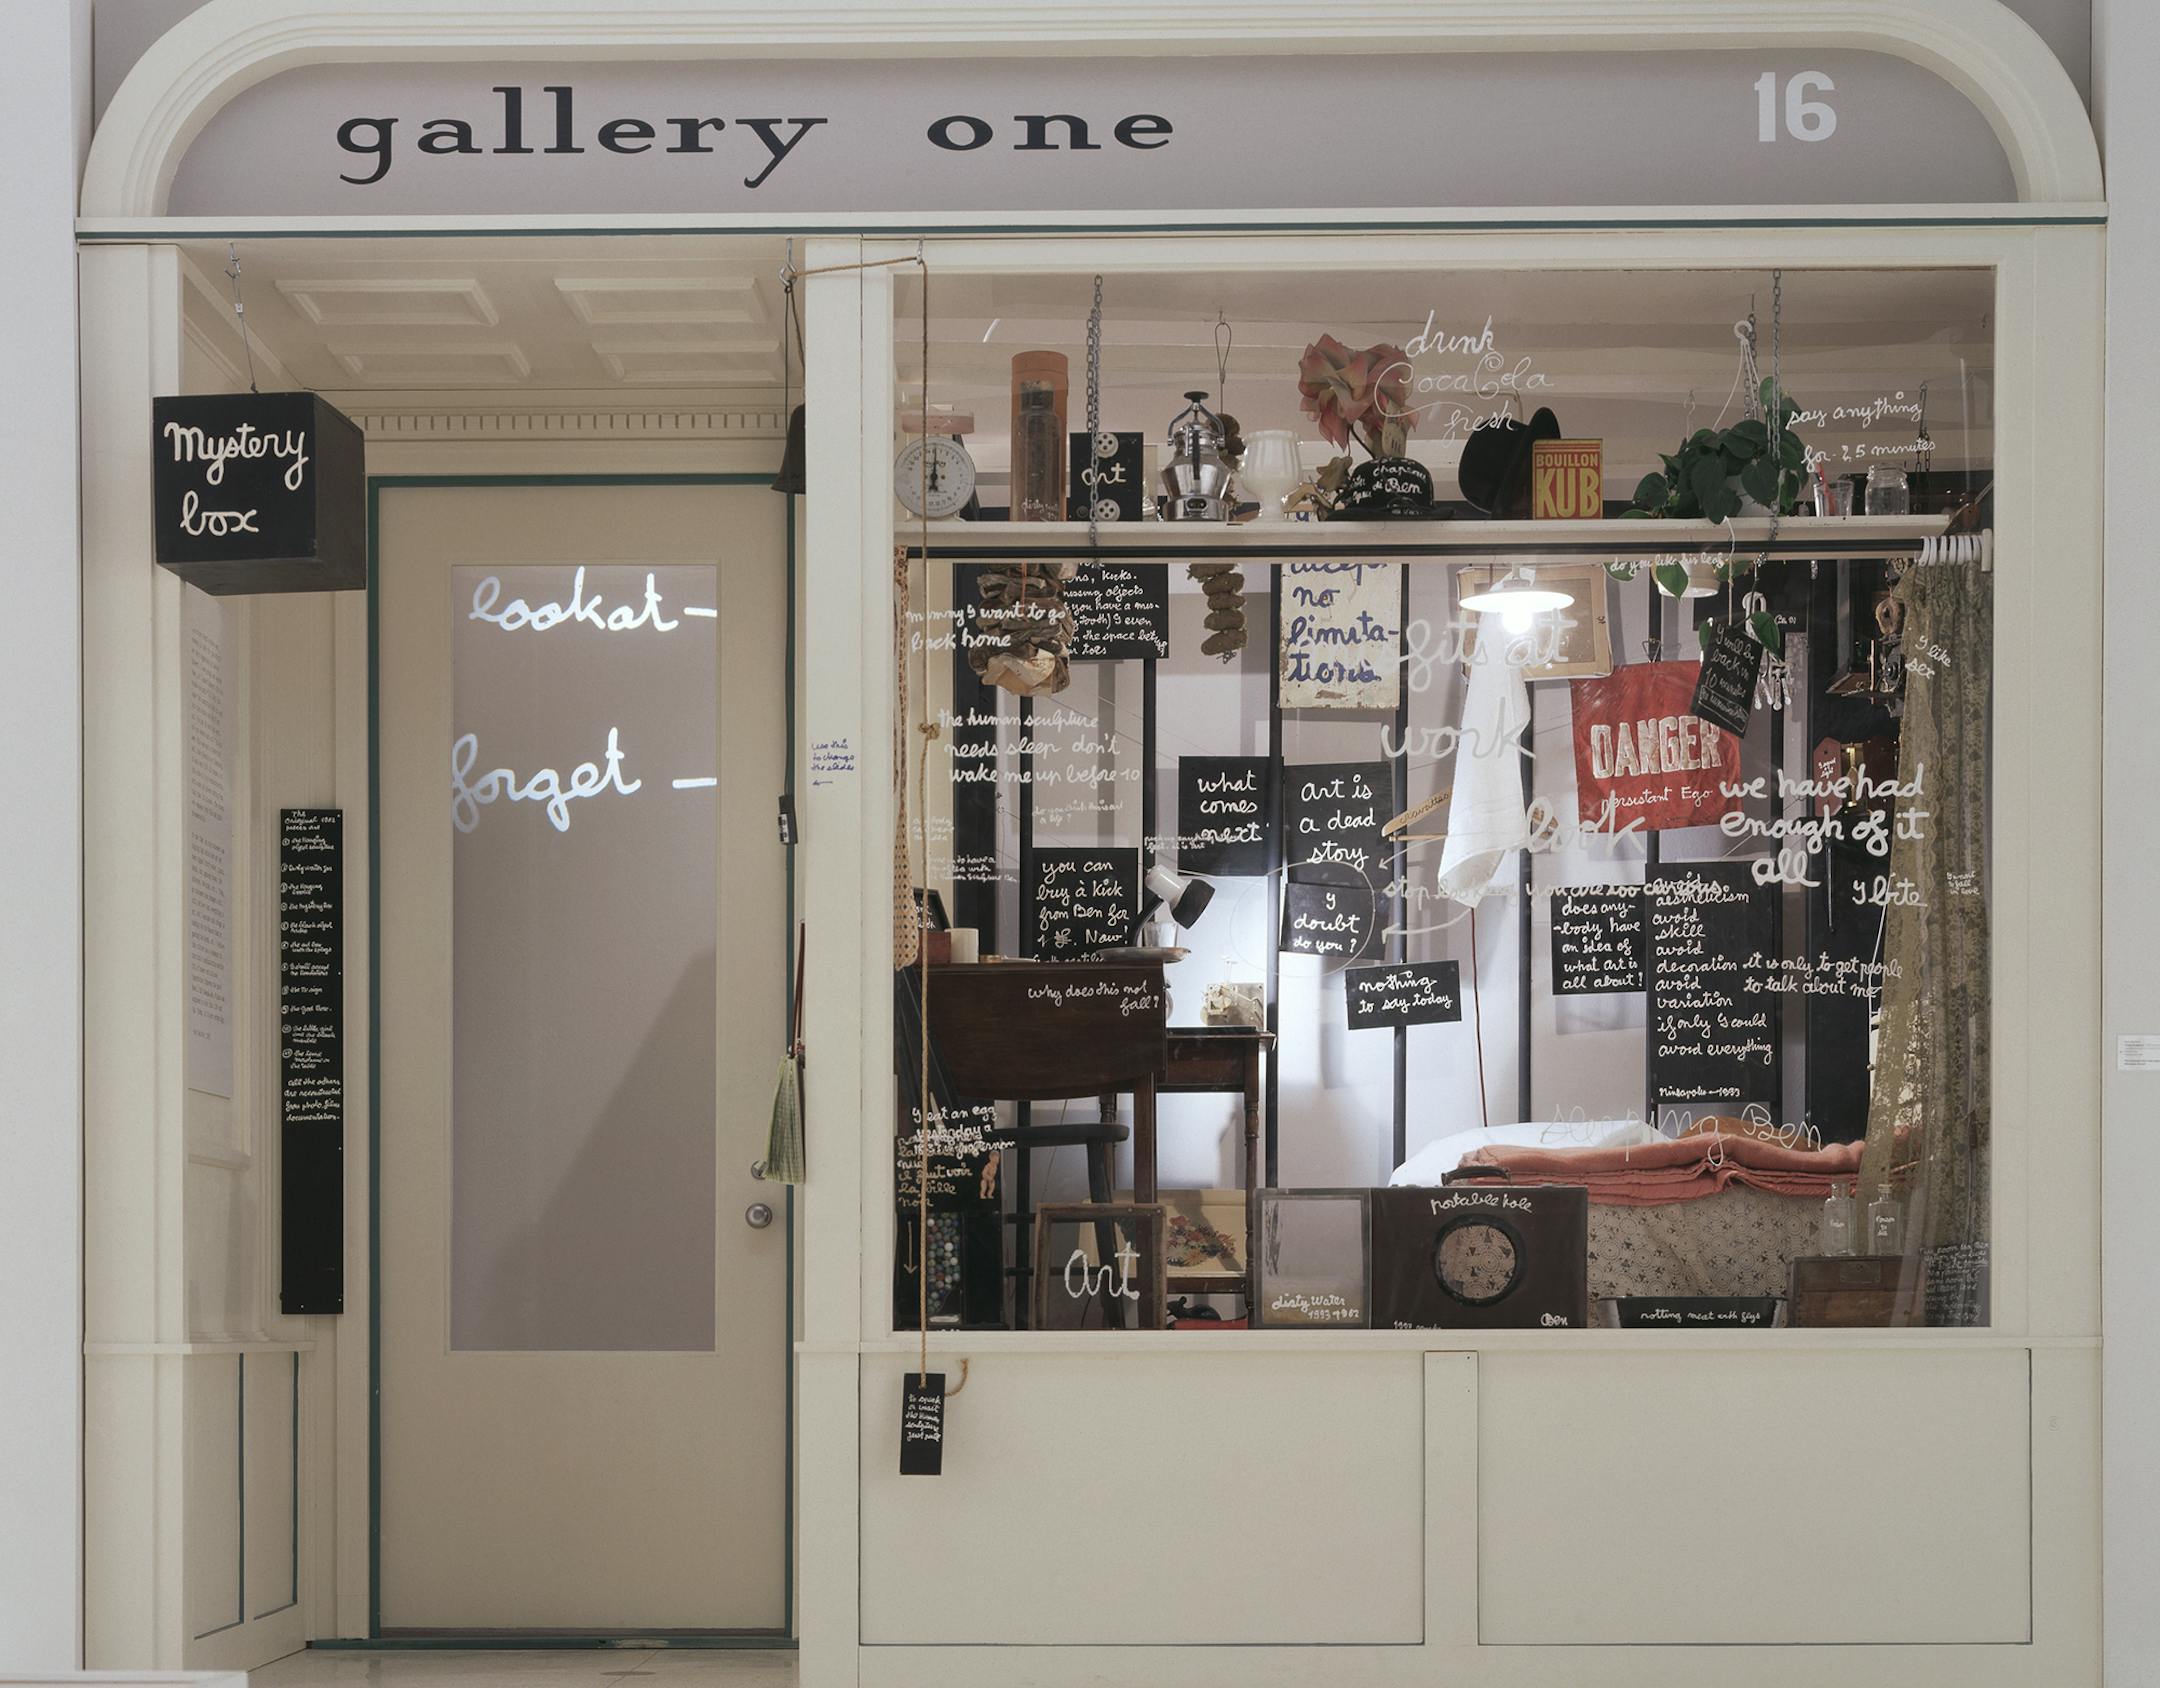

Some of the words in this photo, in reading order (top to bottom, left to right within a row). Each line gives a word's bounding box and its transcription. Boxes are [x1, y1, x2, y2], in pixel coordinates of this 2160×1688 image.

[1754, 71, 1837, 142] 16
[337, 87, 827, 188] gallery
[928, 115, 1173, 150] one
[1405, 309, 1495, 357] drink
[1785, 407, 1828, 429] say
[1832, 391, 1922, 429] anything
[1441, 400, 1515, 448] fresh
[164, 422, 309, 491] Mystery
[1870, 437, 1936, 457] minutes
[1535, 453, 1600, 468] BOUILLON
[1535, 467, 1601, 519] KUB
[180, 491, 260, 537] box
[1123, 602, 1132, 611] a
[1292, 586, 1340, 608] no
[980, 601, 1025, 620] want
[1027, 602, 1047, 620] to
[1047, 608, 1066, 625] go
[961, 627, 1013, 648] home
[1101, 632, 1136, 643] space
[1927, 644, 1952, 668] like
[1904, 657, 1936, 680] sex
[938, 708, 963, 728] the
[967, 707, 1021, 728] human
[1023, 709, 1099, 733] sculpture
[1380, 696, 1537, 760] work
[943, 739, 999, 758] needs
[1004, 736, 1061, 760] sleep
[1071, 732, 1121, 756] don't
[1590, 715, 1723, 780] DANGER
[452, 727, 642, 833] forget
[949, 762, 998, 784] wake
[1003, 770, 1033, 784] me
[1035, 769, 1062, 788] up
[1065, 764, 1116, 789] before
[1120, 769, 1140, 782] 10
[1197, 770, 1258, 792] what
[1351, 774, 1374, 800] is
[1718, 777, 1768, 799] we
[1777, 768, 1848, 800] have
[1855, 763, 1925, 801] had
[1199, 799, 1259, 814] comes
[1681, 786, 1713, 807] Ego
[1299, 818, 1321, 833] a
[1327, 808, 1377, 830] dead
[1718, 804, 1846, 855] enough
[1851, 811, 1889, 857] of
[1896, 807, 1931, 840] it
[1306, 841, 1371, 871] story
[1041, 861, 1077, 885] you
[1083, 860, 1114, 874] can
[1751, 849, 1822, 888] all
[1035, 884, 1071, 906] buy
[1091, 877, 1124, 898] kick
[1382, 875, 1431, 911] stop
[1871, 874, 1928, 907] bite
[1038, 907, 1070, 932] from
[1073, 903, 1103, 920] Ben
[1107, 902, 1130, 927] for
[1561, 896, 1598, 916] does
[1651, 907, 1700, 926] avoid
[1293, 913, 1361, 934] doubt
[1608, 917, 1641, 934] have
[1655, 923, 1706, 941] skill
[1293, 935, 1313, 949] do
[1315, 938, 1344, 953] you
[1561, 943, 1580, 954] an
[1581, 937, 1613, 955] idea
[1616, 938, 1633, 958] of
[1655, 940, 1704, 957] avoid
[1563, 957, 1600, 973] what
[1628, 959, 1639, 970] is
[1656, 955, 1738, 974] decoration
[1742, 953, 1763, 970] it
[1780, 956, 1814, 978] only
[1815, 951, 1835, 972] to
[1835, 956, 1860, 976] get
[1027, 983, 1063, 1007] why
[1065, 983, 1095, 998] does
[1095, 981, 1120, 996] this
[1358, 970, 1438, 995] nothing
[1562, 975, 1587, 990] all
[1655, 973, 1702, 991] avoid
[1743, 976, 1763, 994] to
[1764, 975, 1798, 993] talk
[1802, 976, 1847, 995] about
[1850, 985, 1883, 998] me
[1357, 999, 1375, 1014] to
[1381, 998, 1411, 1014] say
[1411, 993, 1454, 1010] today
[1656, 990, 1734, 1009] variation
[1656, 1016, 1677, 1040] if
[1677, 1015, 1712, 1039] only
[1731, 1012, 1768, 1029] could
[1658, 1042, 1704, 1058] avoid
[1706, 1037, 1774, 1065] everything
[950, 1108, 969, 1120] an
[971, 1105, 998, 1122] egg
[1740, 1103, 1822, 1153] Ben
[945, 1161, 974, 1178] voir
[1430, 1192, 1499, 1215] portable
[1502, 1192, 1533, 1214] hole
[1271, 1293, 1310, 1312] dirty
[1640, 1308, 1683, 1324] rotting
[1686, 1310, 1715, 1321] meat
